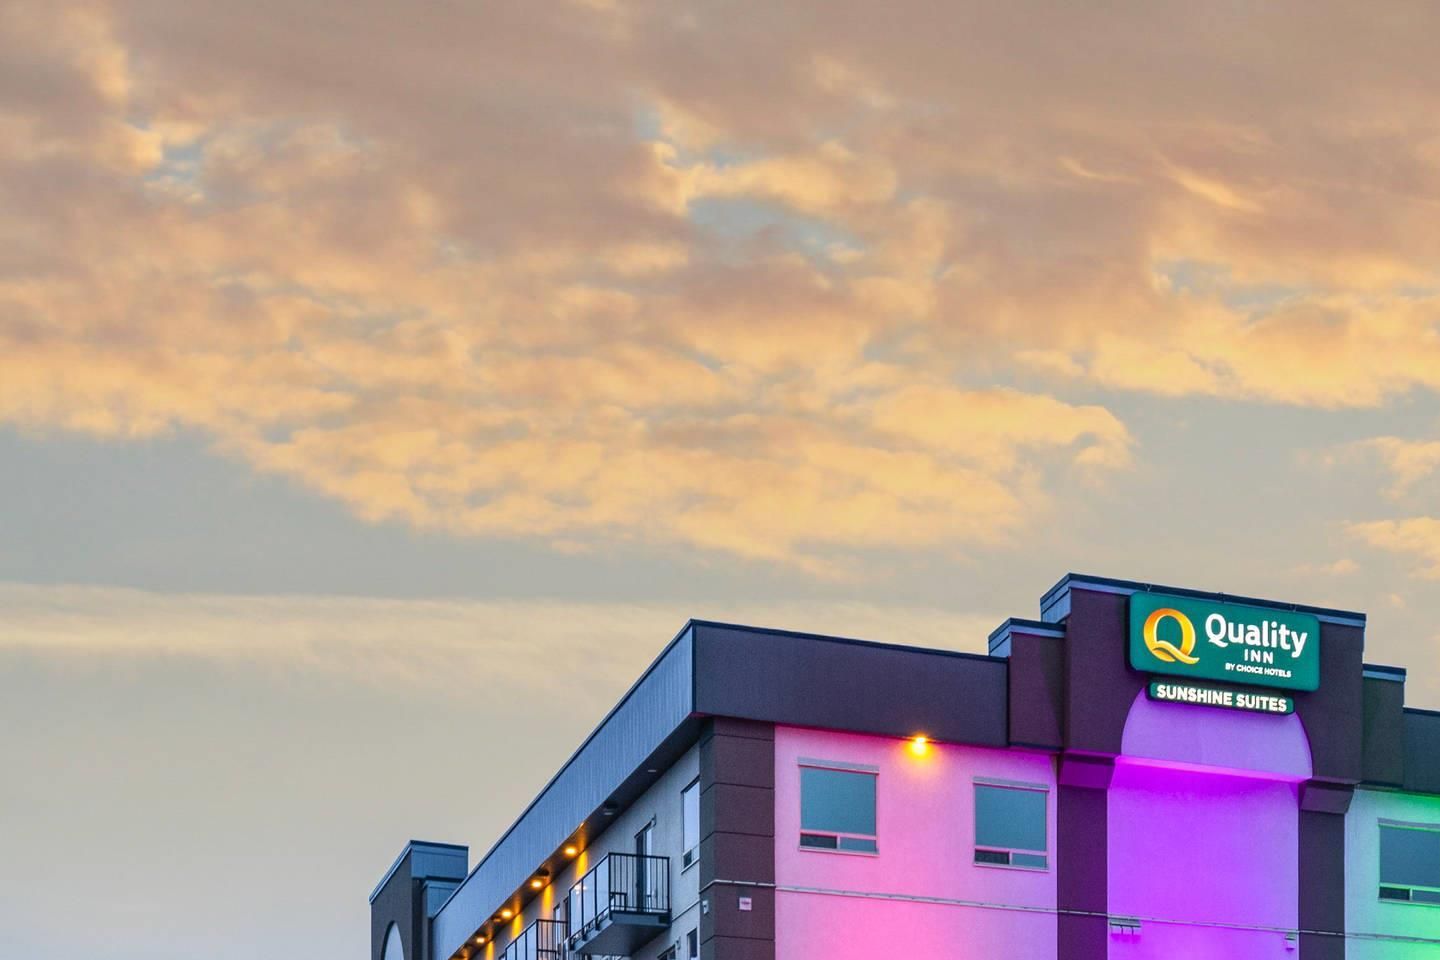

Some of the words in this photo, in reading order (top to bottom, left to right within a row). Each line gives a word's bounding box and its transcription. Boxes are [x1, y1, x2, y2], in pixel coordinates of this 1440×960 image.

[1205, 613, 1308, 658] Quality
[1244, 649, 1274, 665] INN
[1225, 662, 1236, 671] BY
[1236, 665, 1264, 675] CHOICE
[1263, 668, 1292, 678] HOTELS
[1156, 685, 1233, 706] SUNSHINE
[1236, 694, 1287, 713] SUITES
